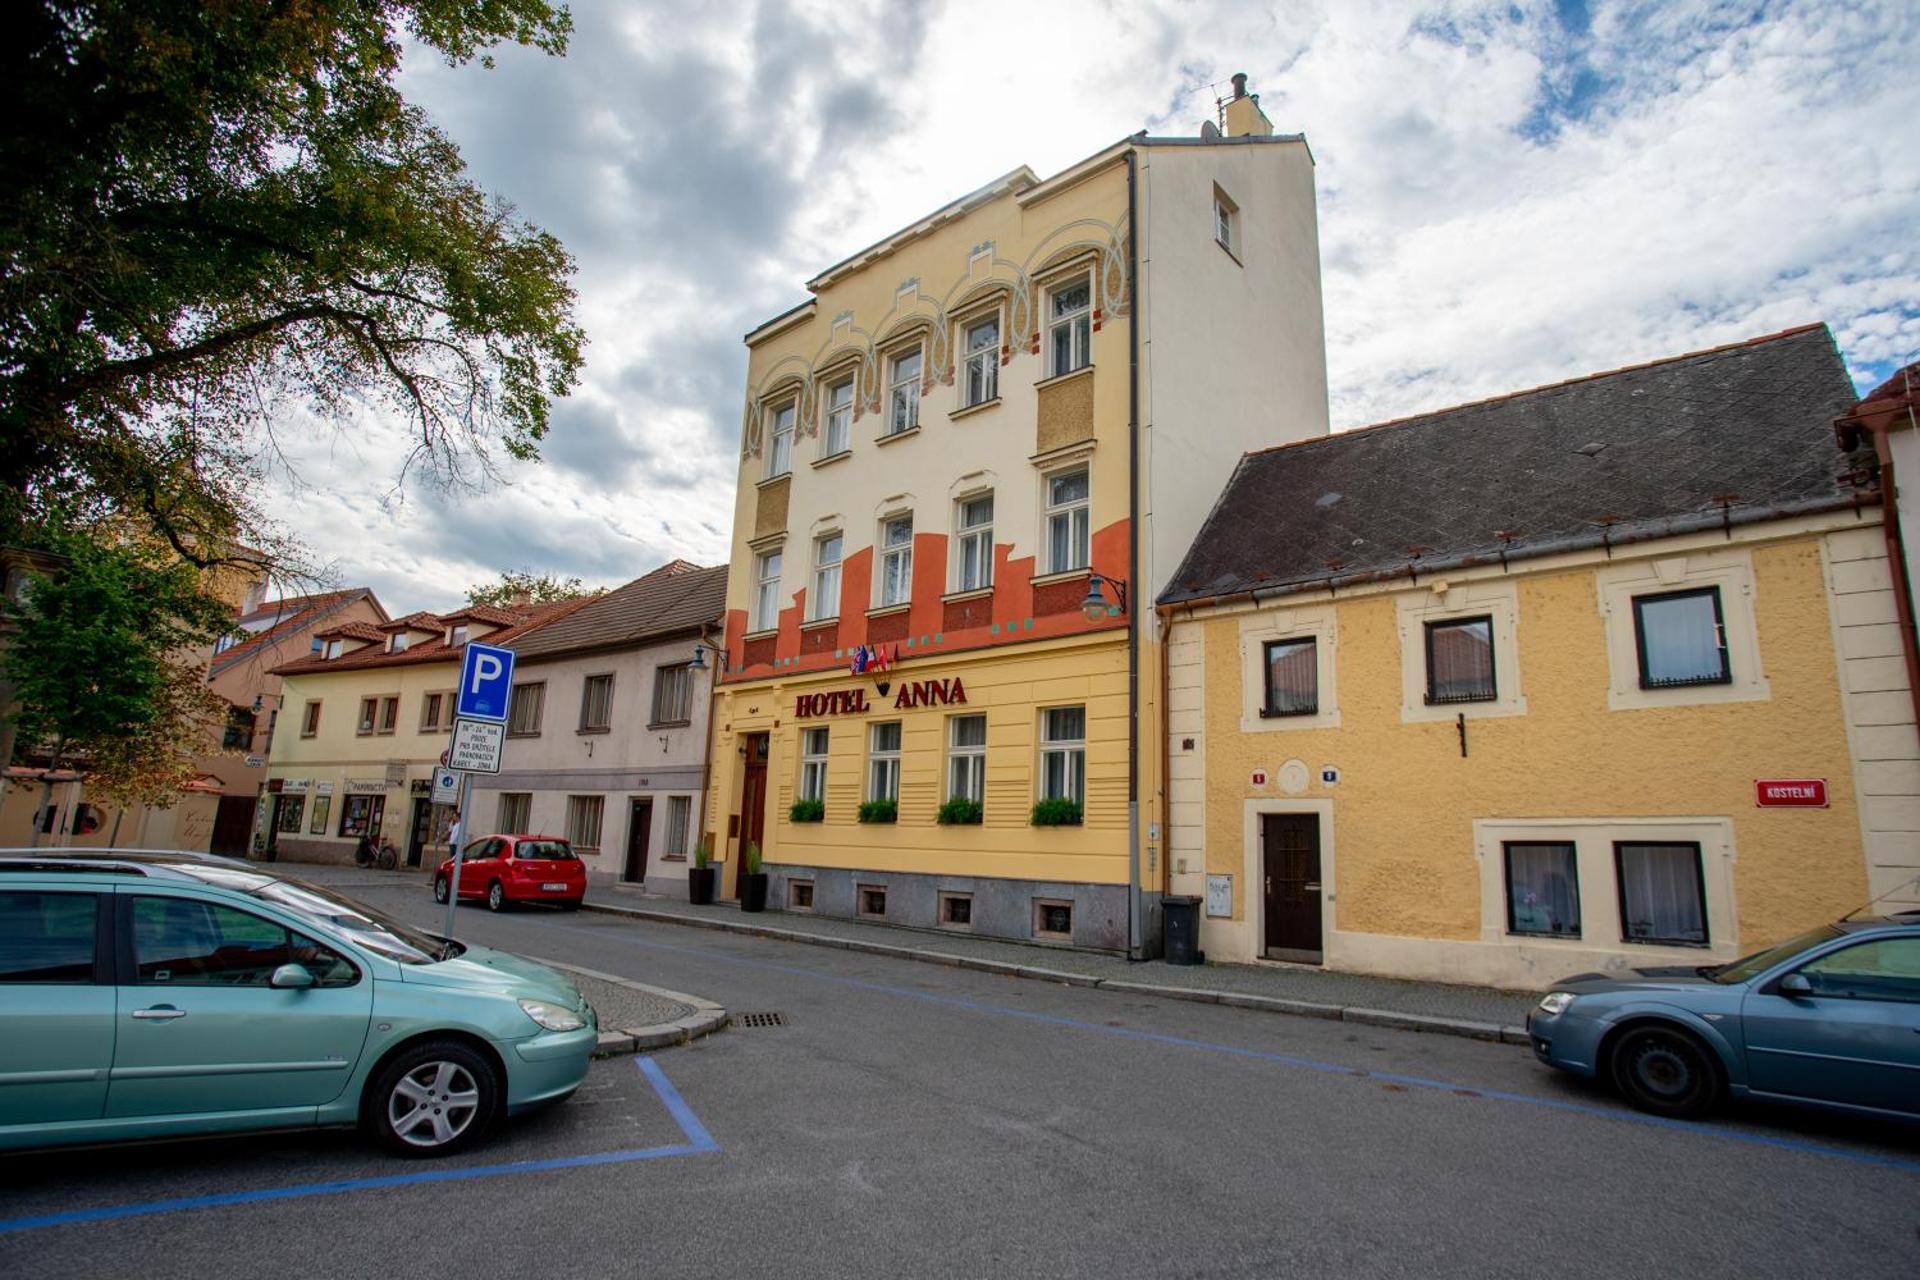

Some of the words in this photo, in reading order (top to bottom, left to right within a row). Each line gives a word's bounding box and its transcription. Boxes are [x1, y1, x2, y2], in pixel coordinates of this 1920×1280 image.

[472, 653, 502, 694] P
[795, 688, 870, 718] HOTEL
[894, 676, 967, 709] ANNA
[459, 742, 470, 750] PRO
[1767, 784, 1816, 799] KOSTELNÍ
